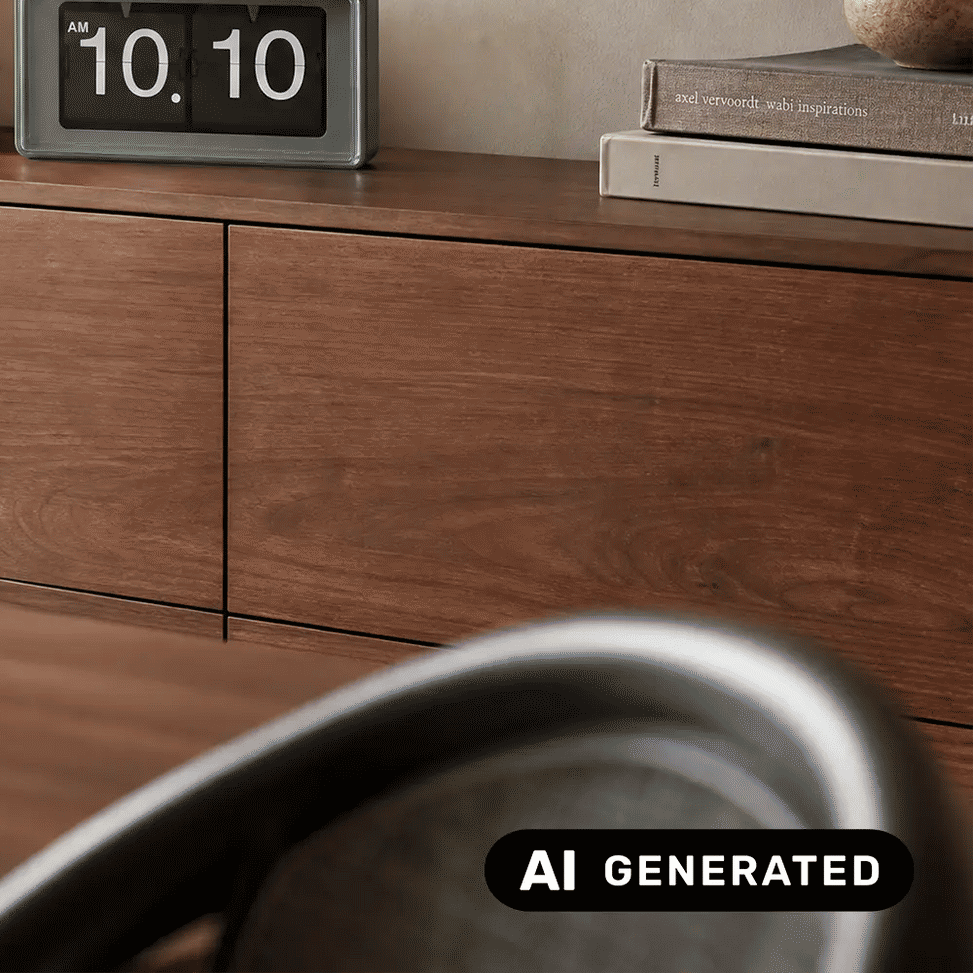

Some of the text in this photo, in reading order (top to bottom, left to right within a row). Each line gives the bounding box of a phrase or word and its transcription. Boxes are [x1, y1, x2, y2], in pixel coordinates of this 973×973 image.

[67, 21, 89, 33] AM
[213, 29, 305, 101] 10
[675, 91, 869, 118] axel vervoordt wabi inspirations
